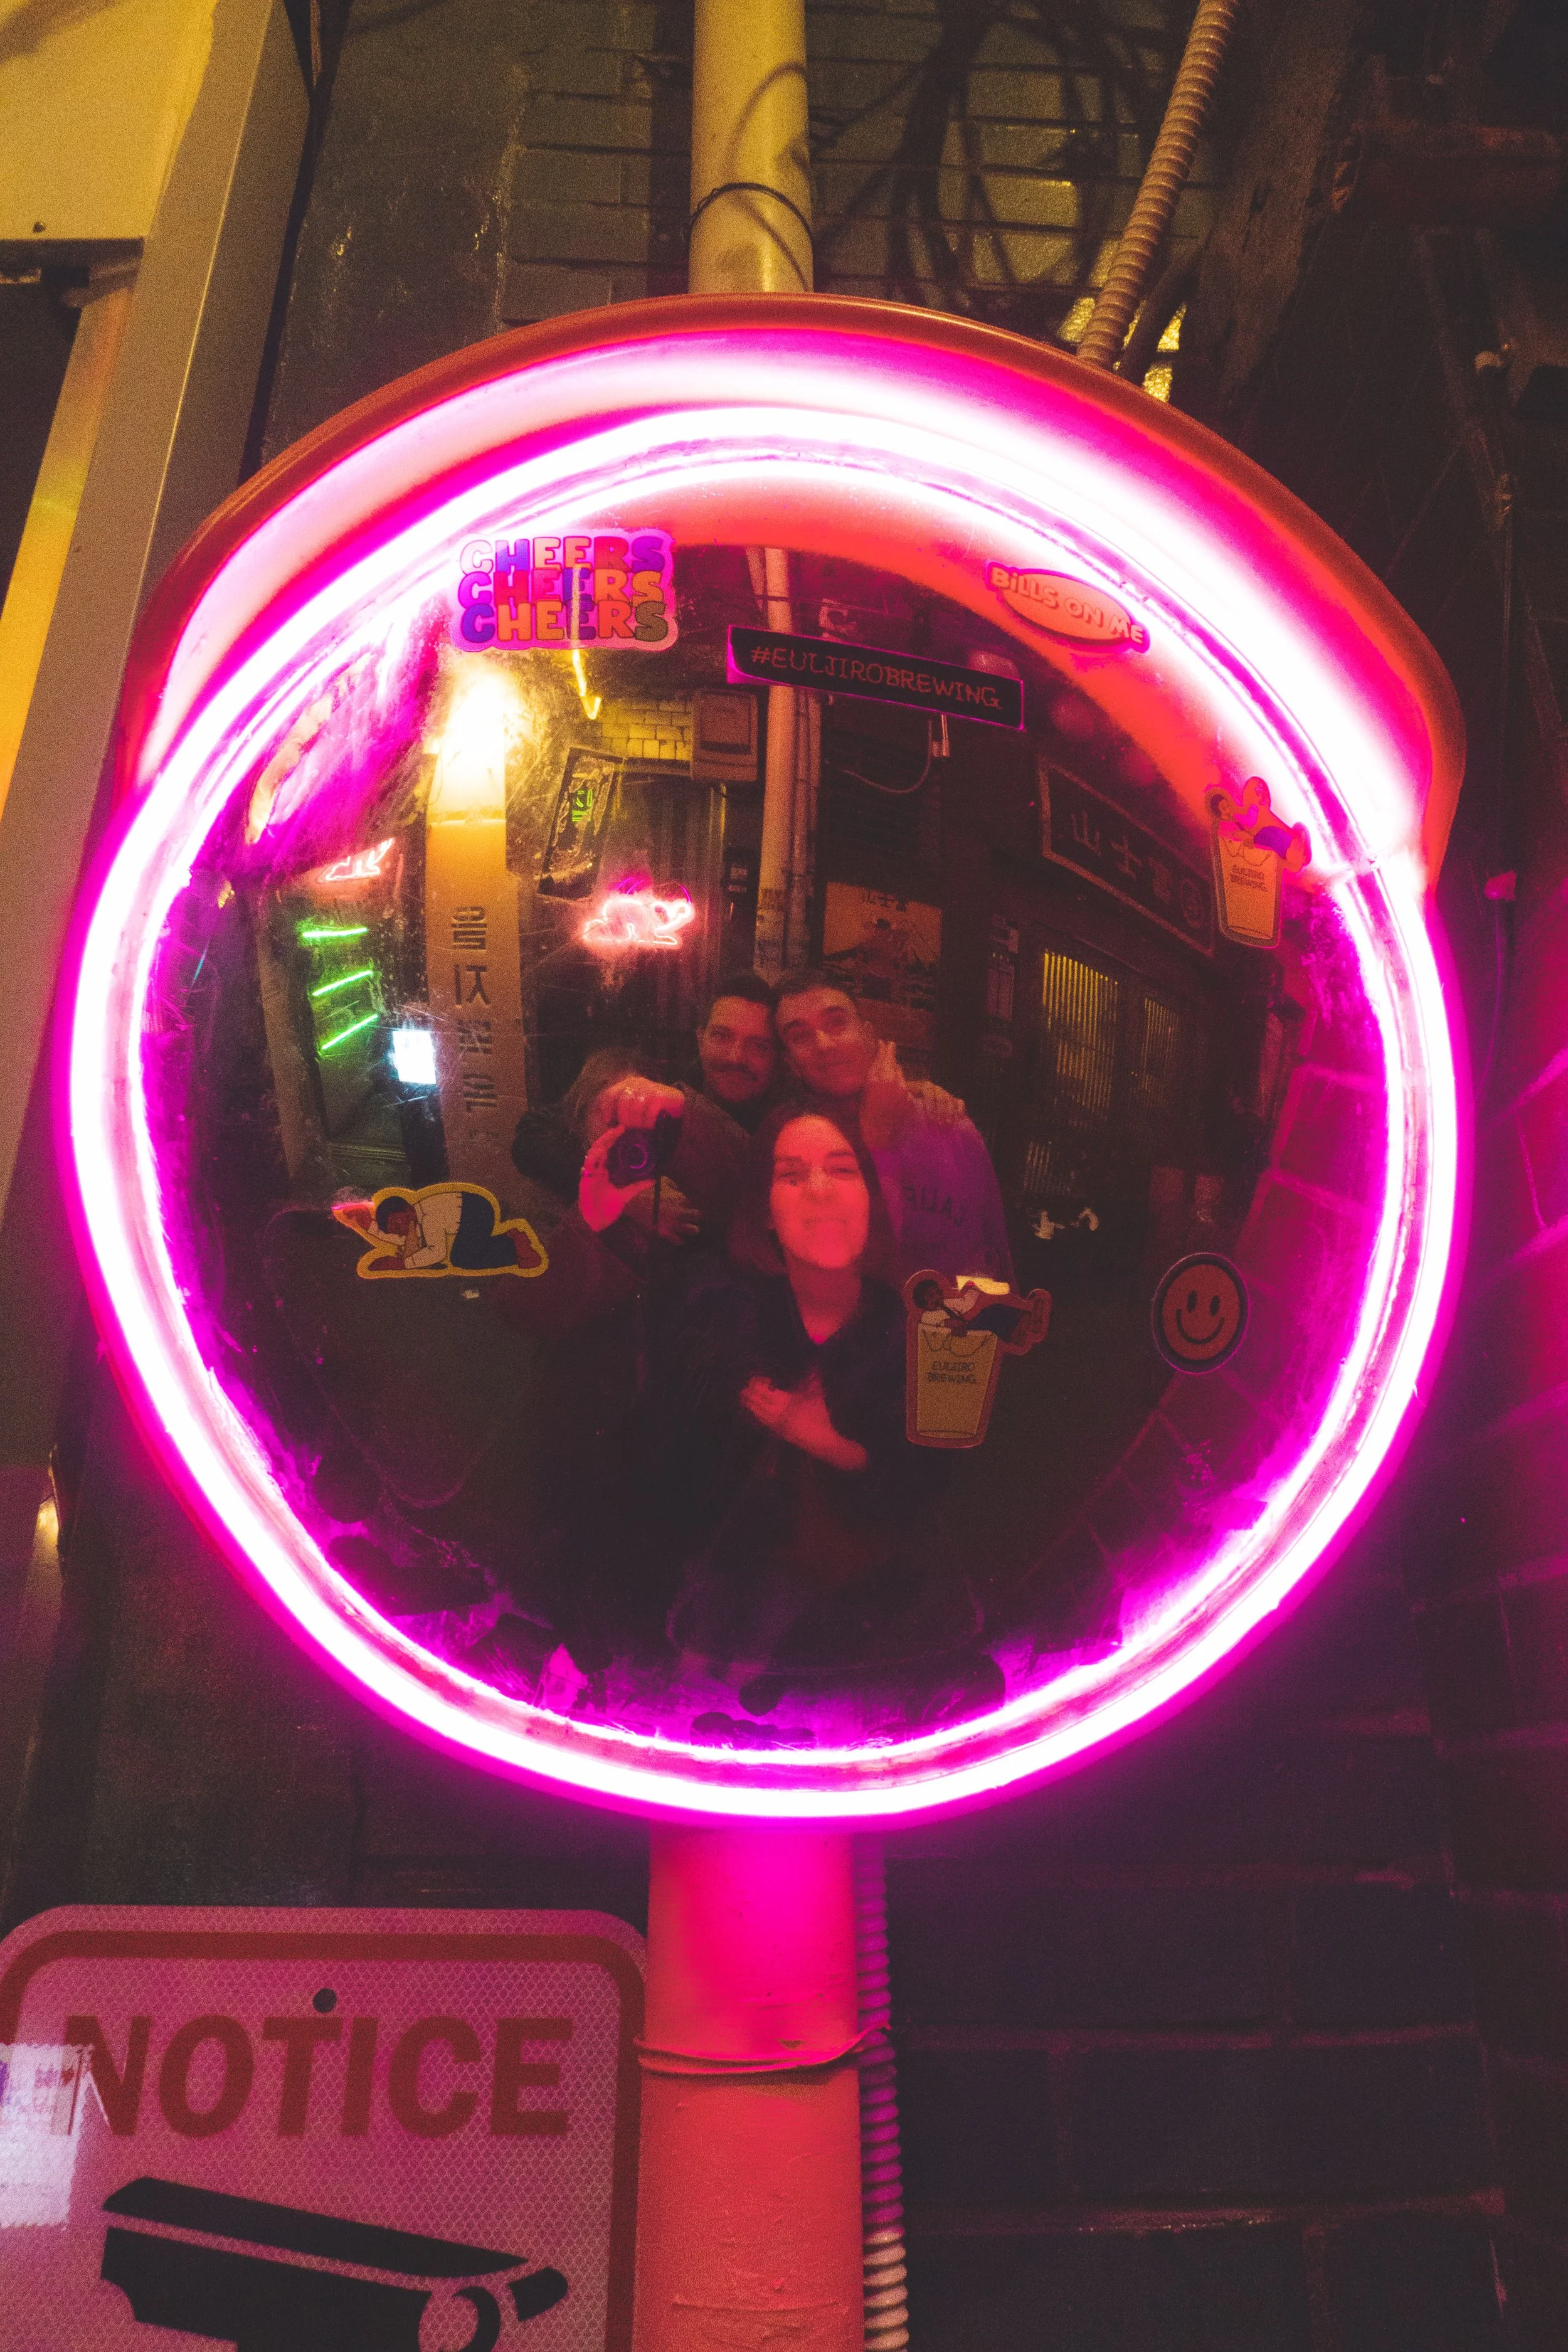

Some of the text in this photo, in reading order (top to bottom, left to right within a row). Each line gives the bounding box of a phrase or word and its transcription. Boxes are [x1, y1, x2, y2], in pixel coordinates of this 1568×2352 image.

[460, 536, 665, 575] CHEERS
[457, 567, 664, 609] CHEERS
[461, 600, 669, 643] CHEERS
[1064, 596, 1104, 628] ON
[1109, 615, 1144, 644] ME
[53, 2015, 574, 2138] NOTICE
